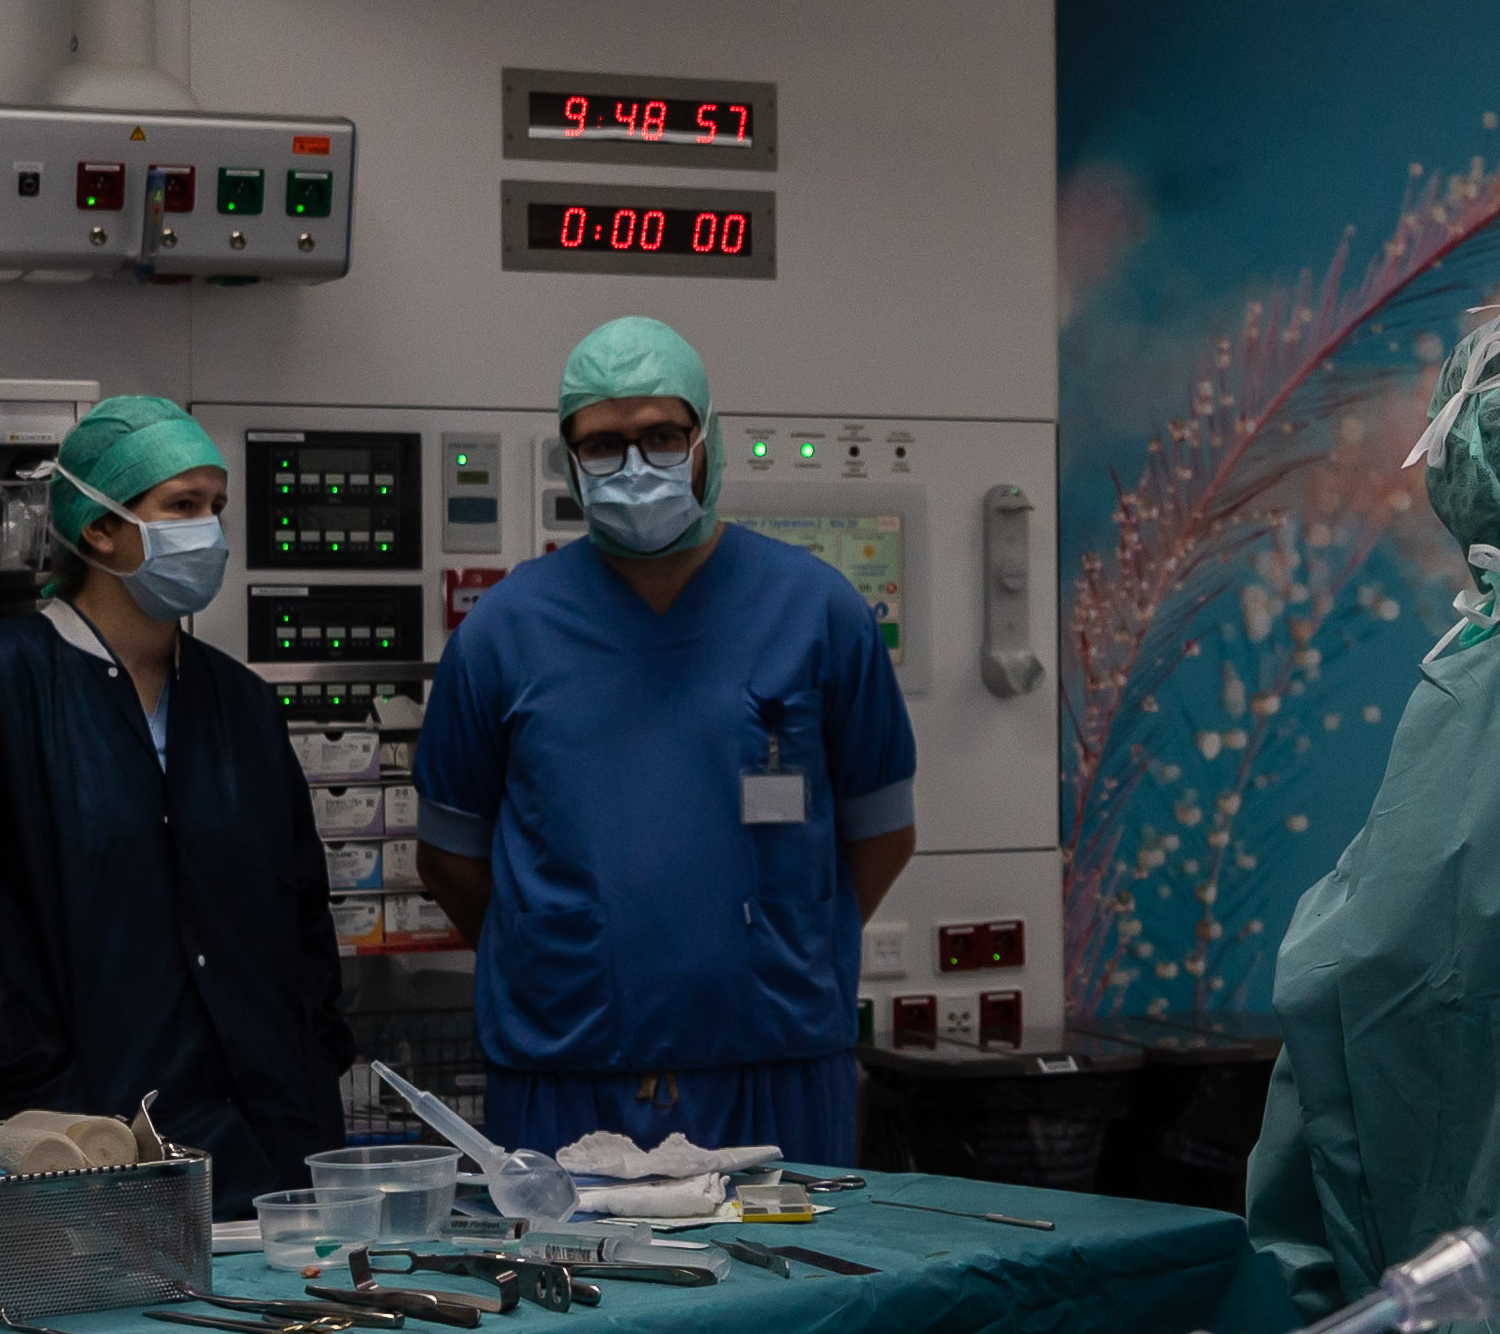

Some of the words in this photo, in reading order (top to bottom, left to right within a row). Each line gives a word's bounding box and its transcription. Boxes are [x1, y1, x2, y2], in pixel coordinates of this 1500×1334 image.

[695, 104, 748, 144] 57
[560, 207, 666, 251] 0:00
[692, 213, 746, 254] 00
